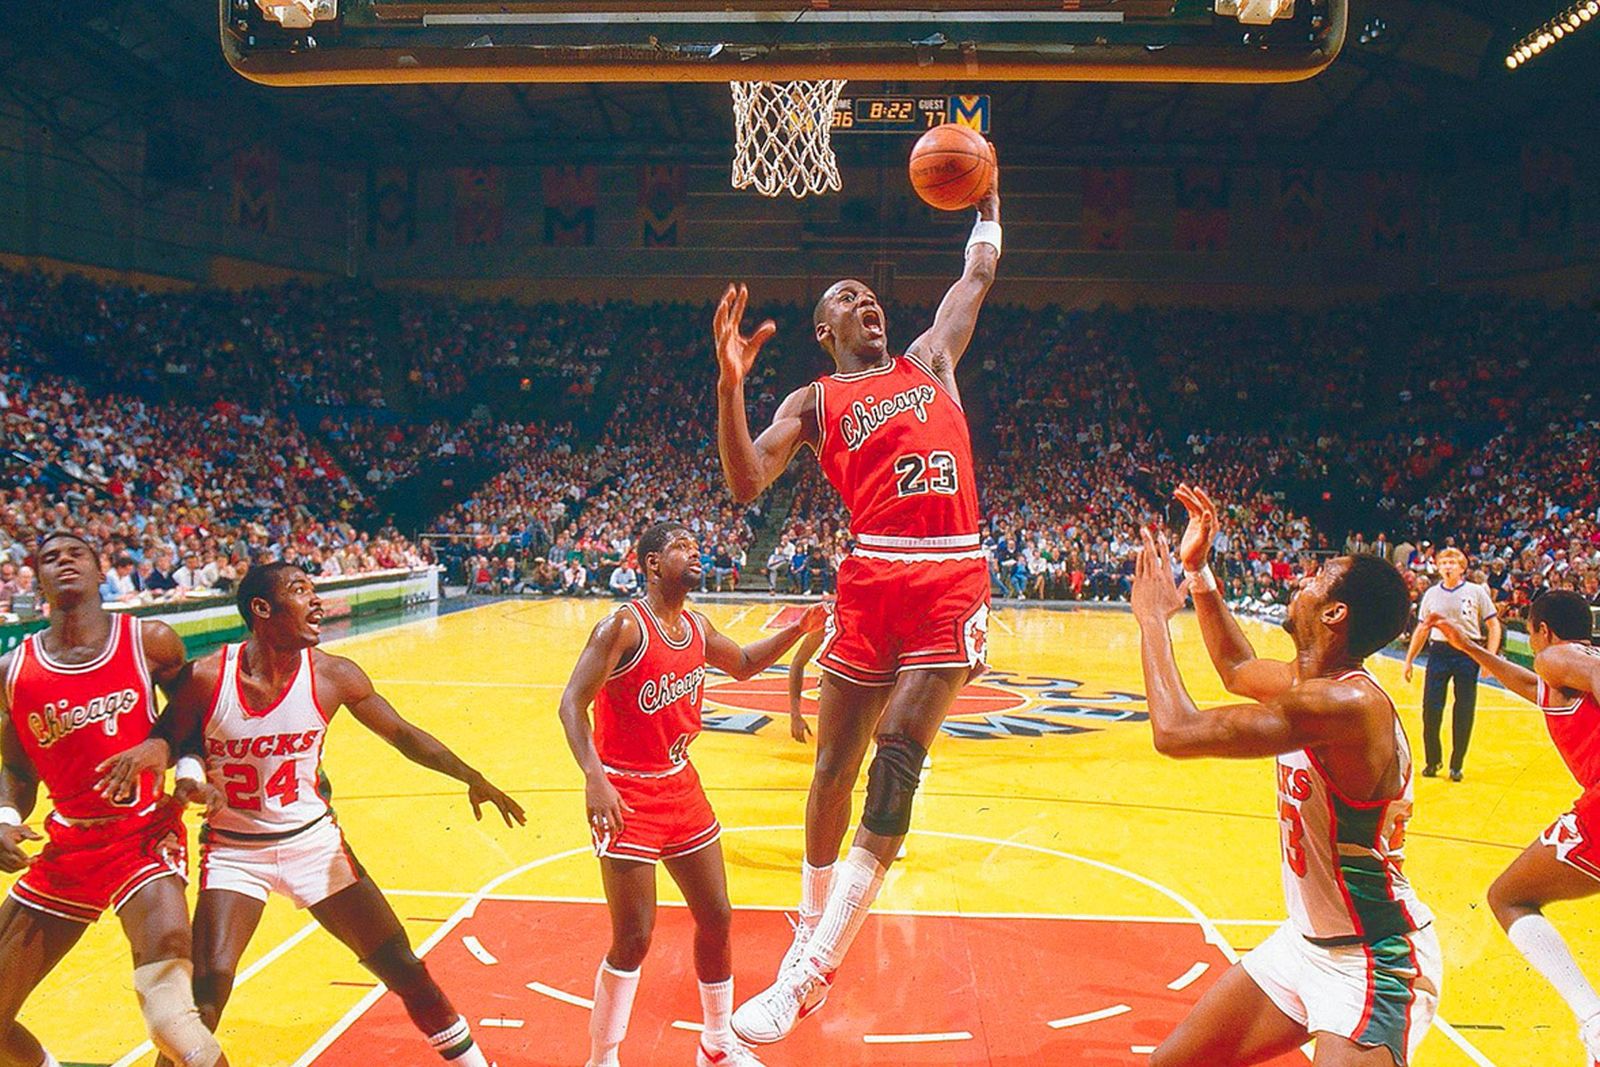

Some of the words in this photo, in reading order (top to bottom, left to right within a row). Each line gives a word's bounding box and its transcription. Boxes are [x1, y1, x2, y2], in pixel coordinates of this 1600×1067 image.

[870, 102, 912, 119] 8:22
[918, 99, 945, 110] GUEST
[840, 384, 936, 452] Chicago
[894, 450, 959, 498] 23
[28, 688, 139, 748] Chicago
[207, 729, 321, 759] BUCKS
[669, 733, 688, 766] 4
[222, 759, 299, 812] 24
[1278, 801, 1308, 878] 3
